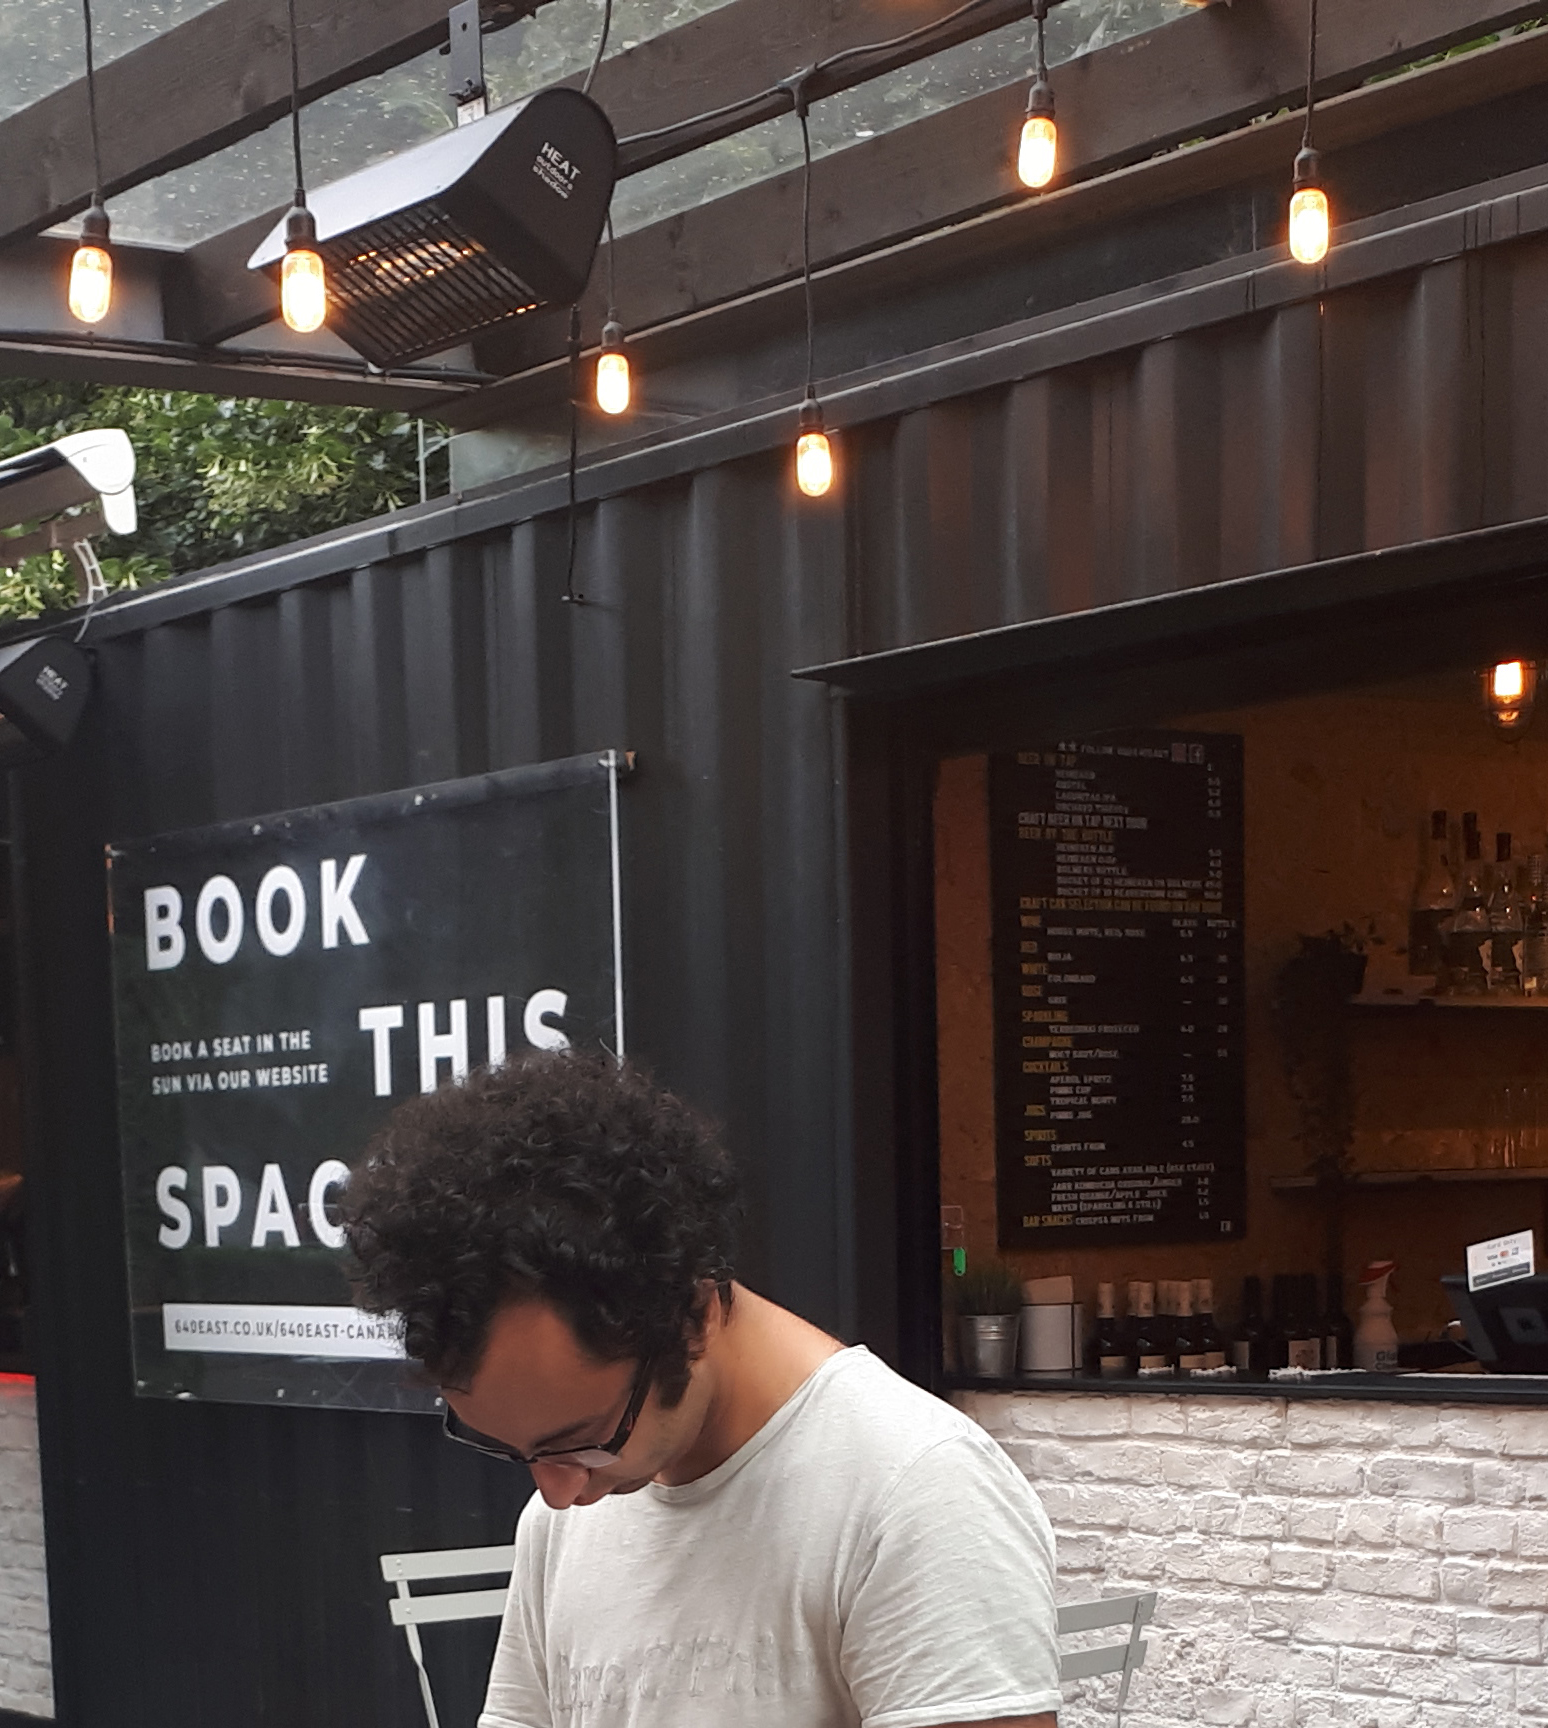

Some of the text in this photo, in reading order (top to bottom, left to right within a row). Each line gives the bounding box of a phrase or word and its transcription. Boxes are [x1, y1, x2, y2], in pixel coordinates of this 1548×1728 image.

[541, 141, 581, 180] HEAT
[143, 853, 371, 972] BOOK
[150, 1029, 312, 1063] BOOK A SEAT IN THE
[359, 988, 572, 1097] THIS
[152, 1062, 329, 1096] SUN VIA OUR WEBSITE
[155, 1158, 352, 1251] SPAC
